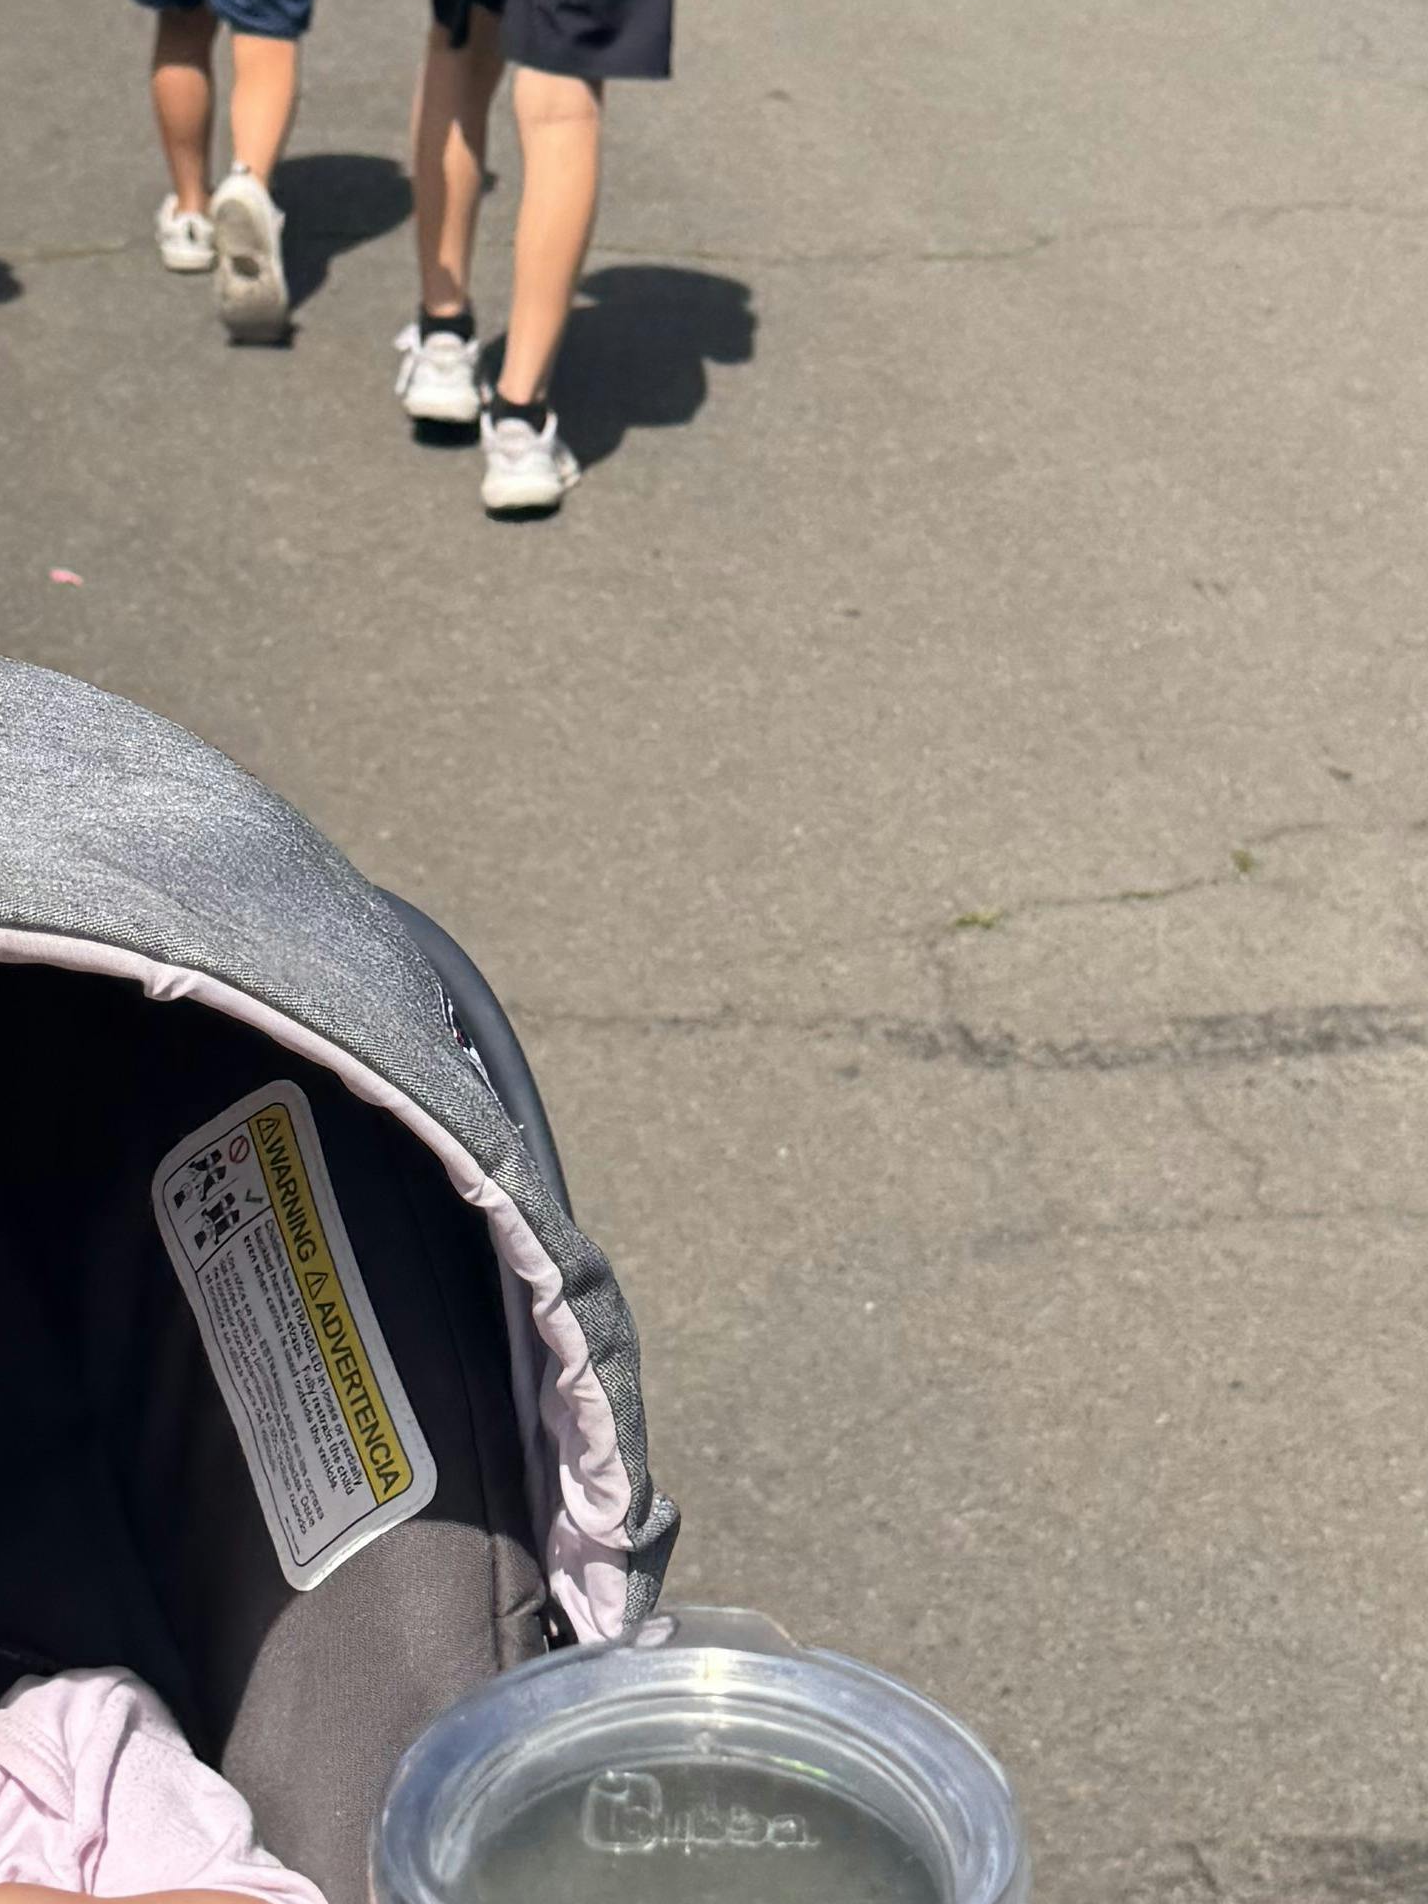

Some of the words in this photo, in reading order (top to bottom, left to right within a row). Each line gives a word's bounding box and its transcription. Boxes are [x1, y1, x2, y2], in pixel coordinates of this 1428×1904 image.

[265, 1135, 317, 1263] WARNING
[316, 1300, 401, 1495] ADVERTENCIA
[291, 1299, 327, 1372] STRANGLED
[309, 1423, 321, 1444] the
[329, 1442, 341, 1464] the
